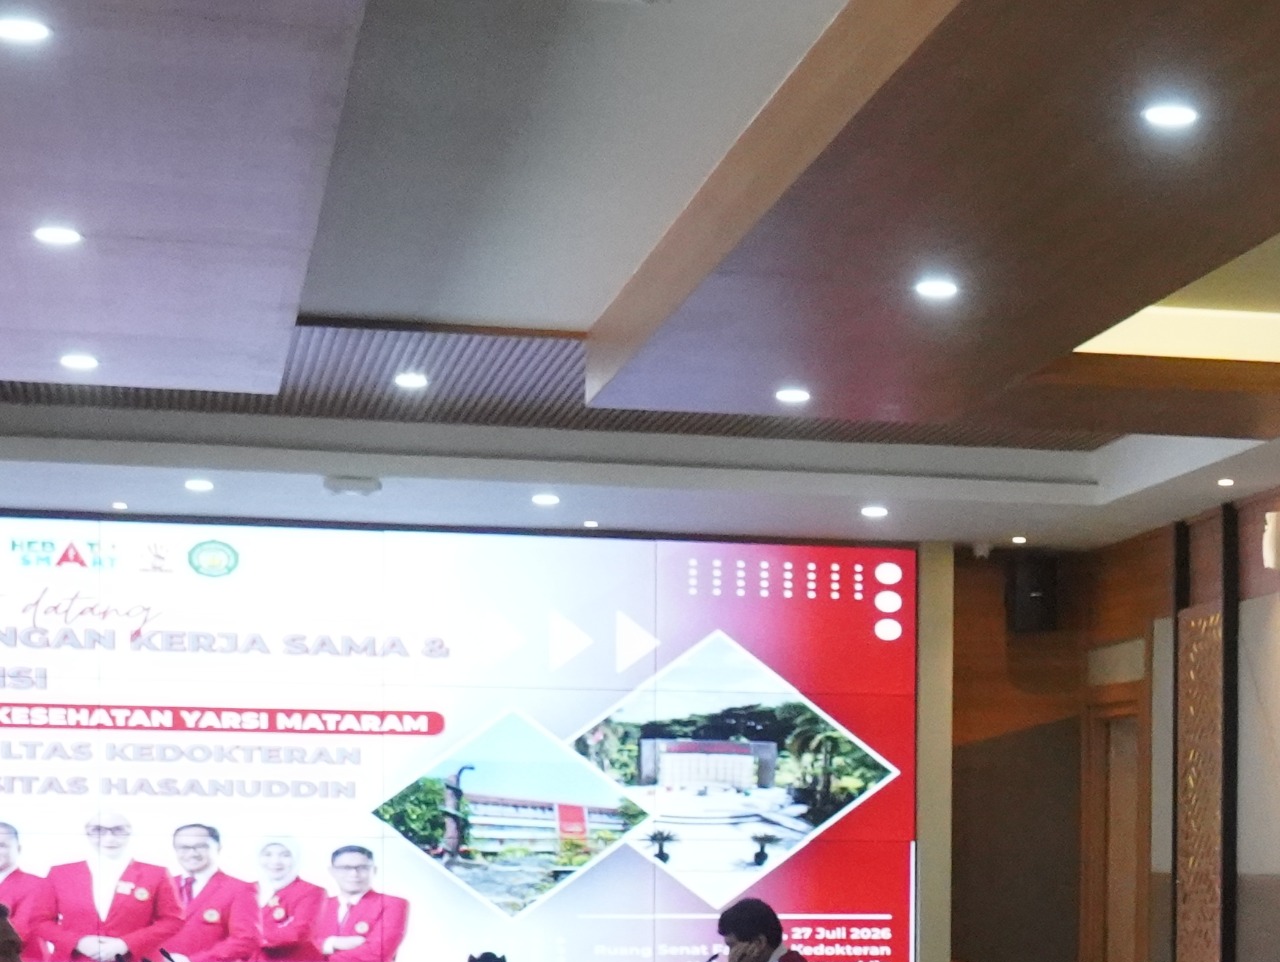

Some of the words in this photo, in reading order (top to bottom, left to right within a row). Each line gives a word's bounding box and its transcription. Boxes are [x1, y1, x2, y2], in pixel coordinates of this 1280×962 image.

[130, 630, 270, 654] KERJA
[282, 633, 410, 658] SAMA
[421, 637, 450, 658] &
[180, 709, 269, 730] YARSI
[276, 712, 429, 733] MATARAM
[105, 742, 361, 766] KEDOKTERAN
[0, 775, 89, 795] ITAS
[101, 777, 356, 799] HASANUDDIN
[790, 926, 813, 940] 27
[814, 925, 847, 940] Juli
[657, 943, 709, 956] Senat
